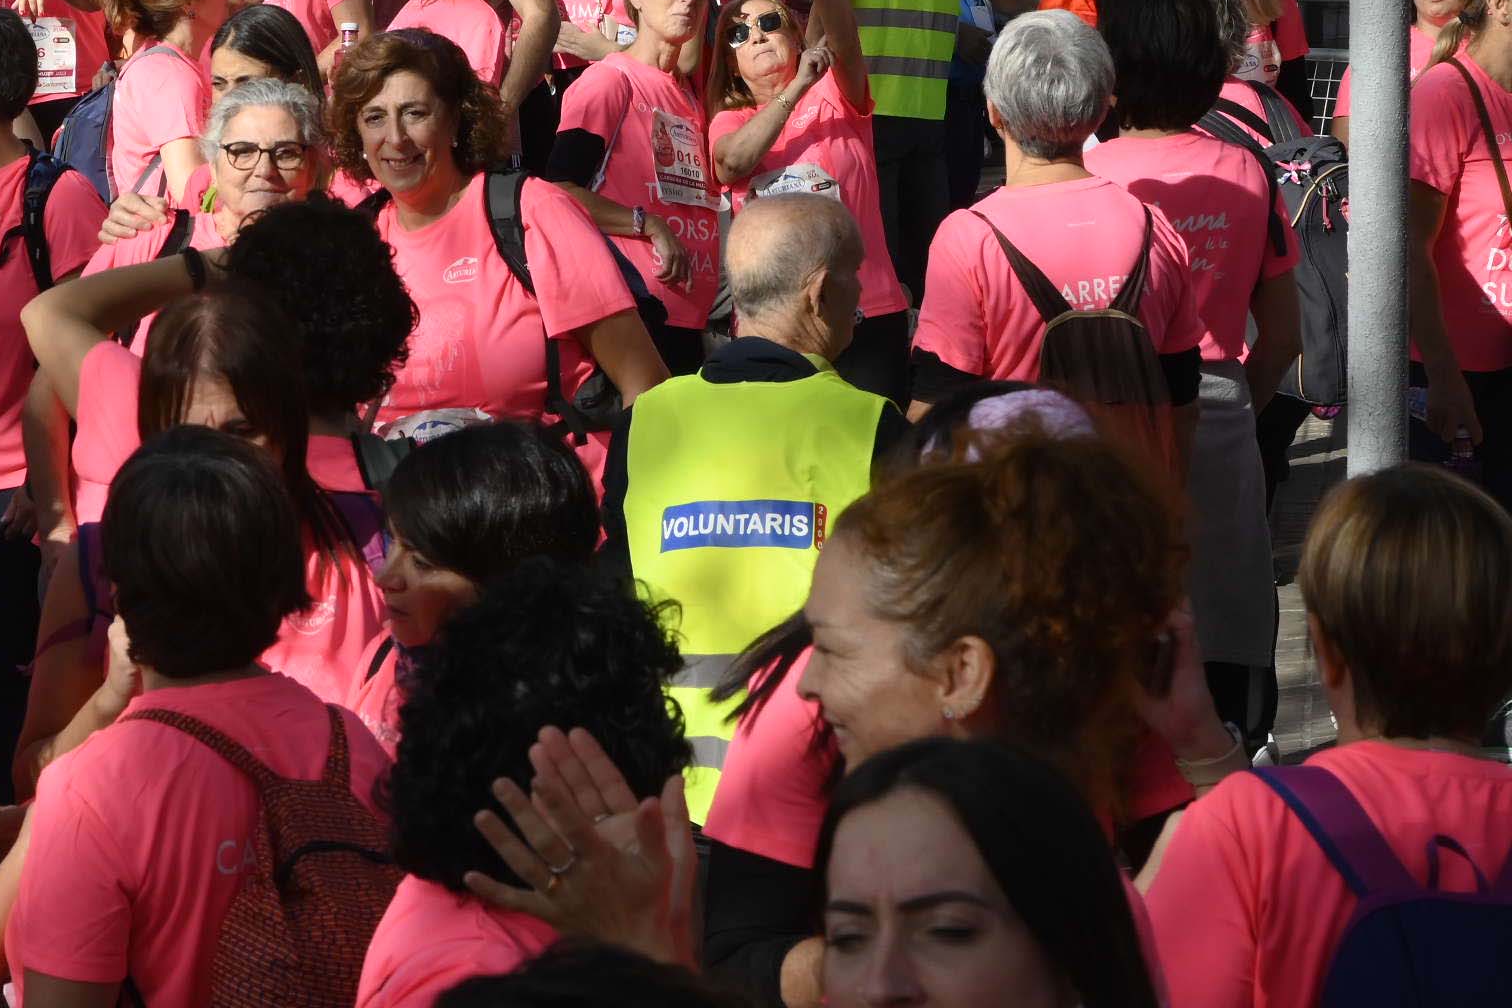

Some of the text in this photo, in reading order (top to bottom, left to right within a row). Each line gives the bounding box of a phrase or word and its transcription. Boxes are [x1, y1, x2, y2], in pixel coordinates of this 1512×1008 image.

[677, 149, 701, 167] 016
[680, 166, 700, 179] 16010
[666, 215, 719, 241] ORSA
[651, 246, 714, 274] SMA
[1481, 281, 1512, 308] SU
[662, 513, 809, 540] VOLUNTARIS
[216, 840, 257, 876] CA
